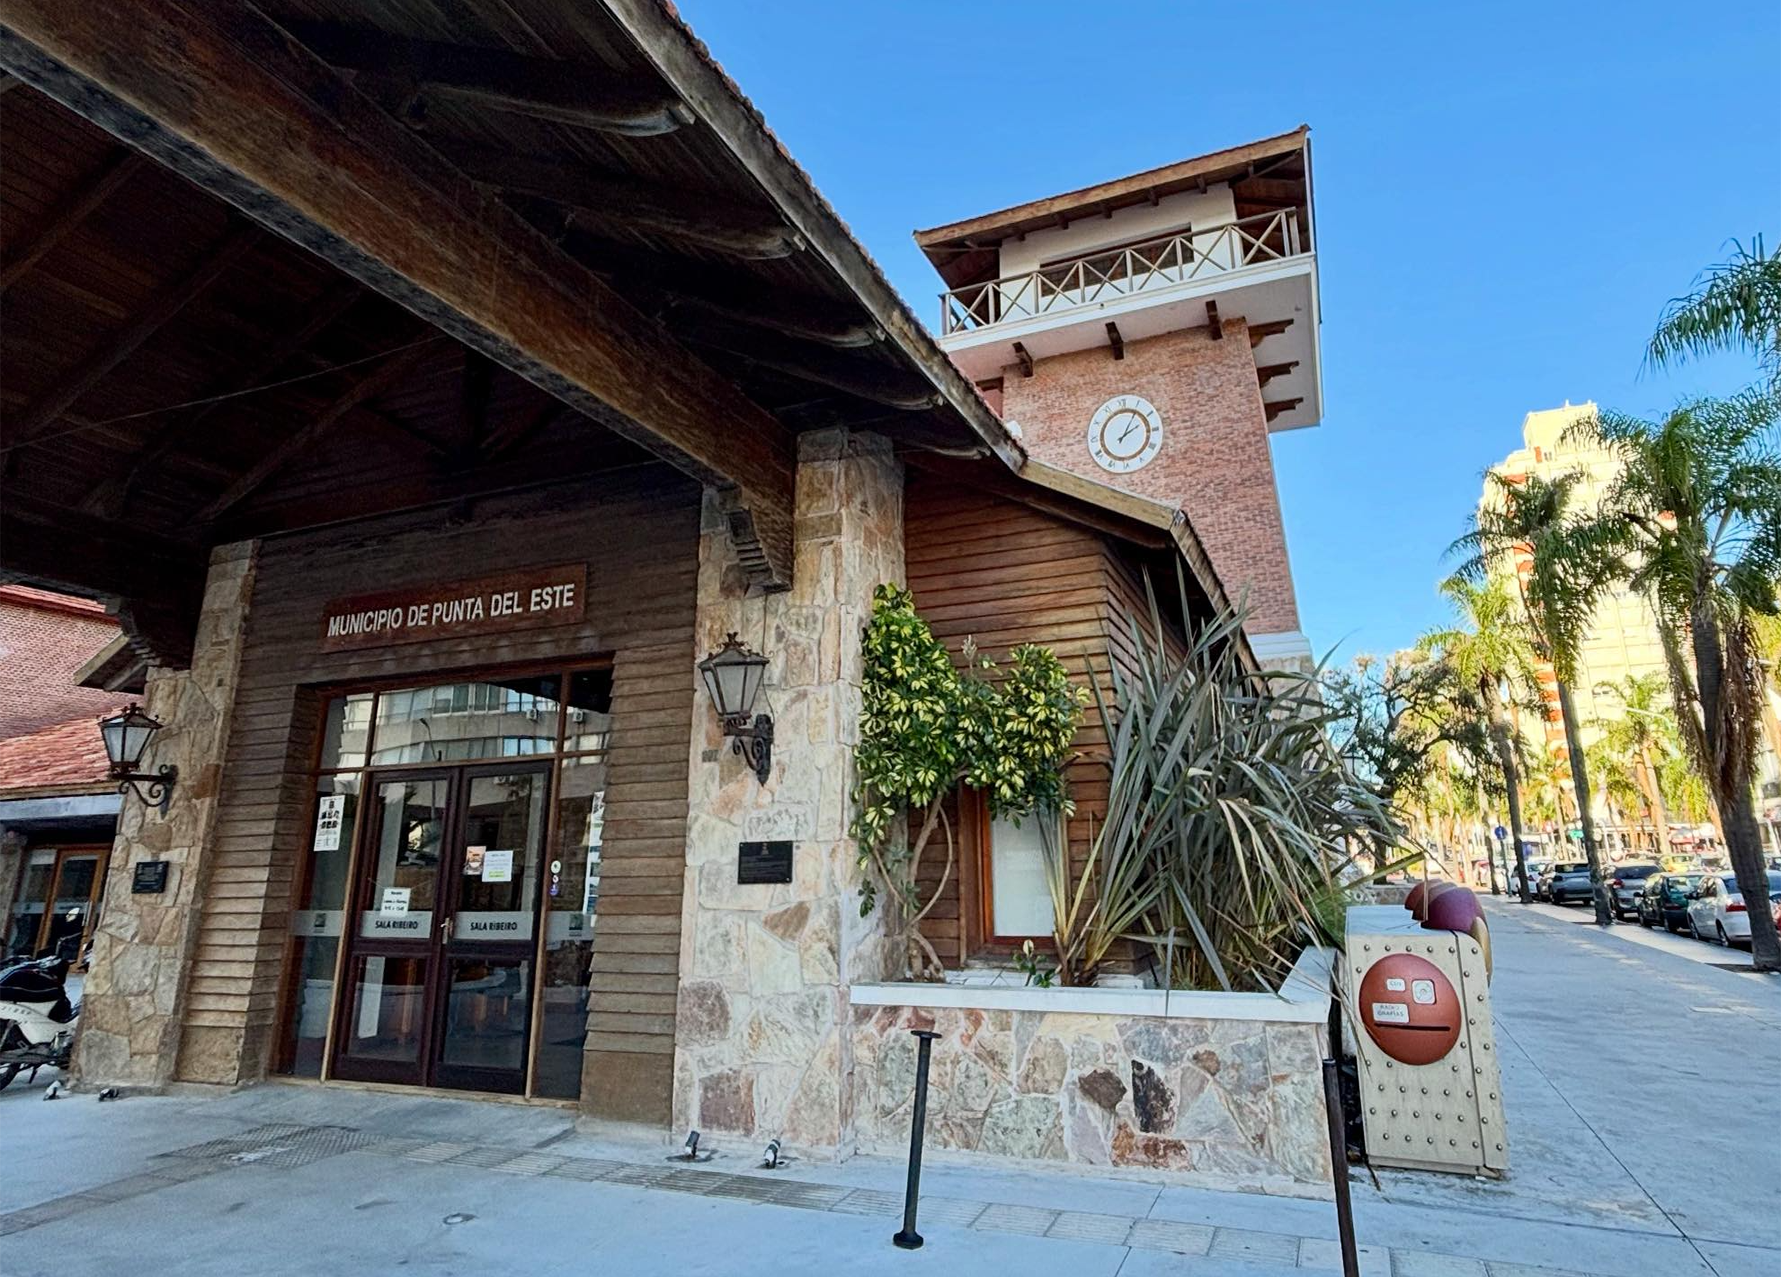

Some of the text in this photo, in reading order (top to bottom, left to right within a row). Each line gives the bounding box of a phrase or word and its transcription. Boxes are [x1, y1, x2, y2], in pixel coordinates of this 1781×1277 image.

[327, 584, 575, 637] MUNICIPIO DE PUNTA DEL ESTE
[375, 920, 419, 930] SALA RIBEIRO
[470, 921, 518, 931] SALA RIBEIRO
